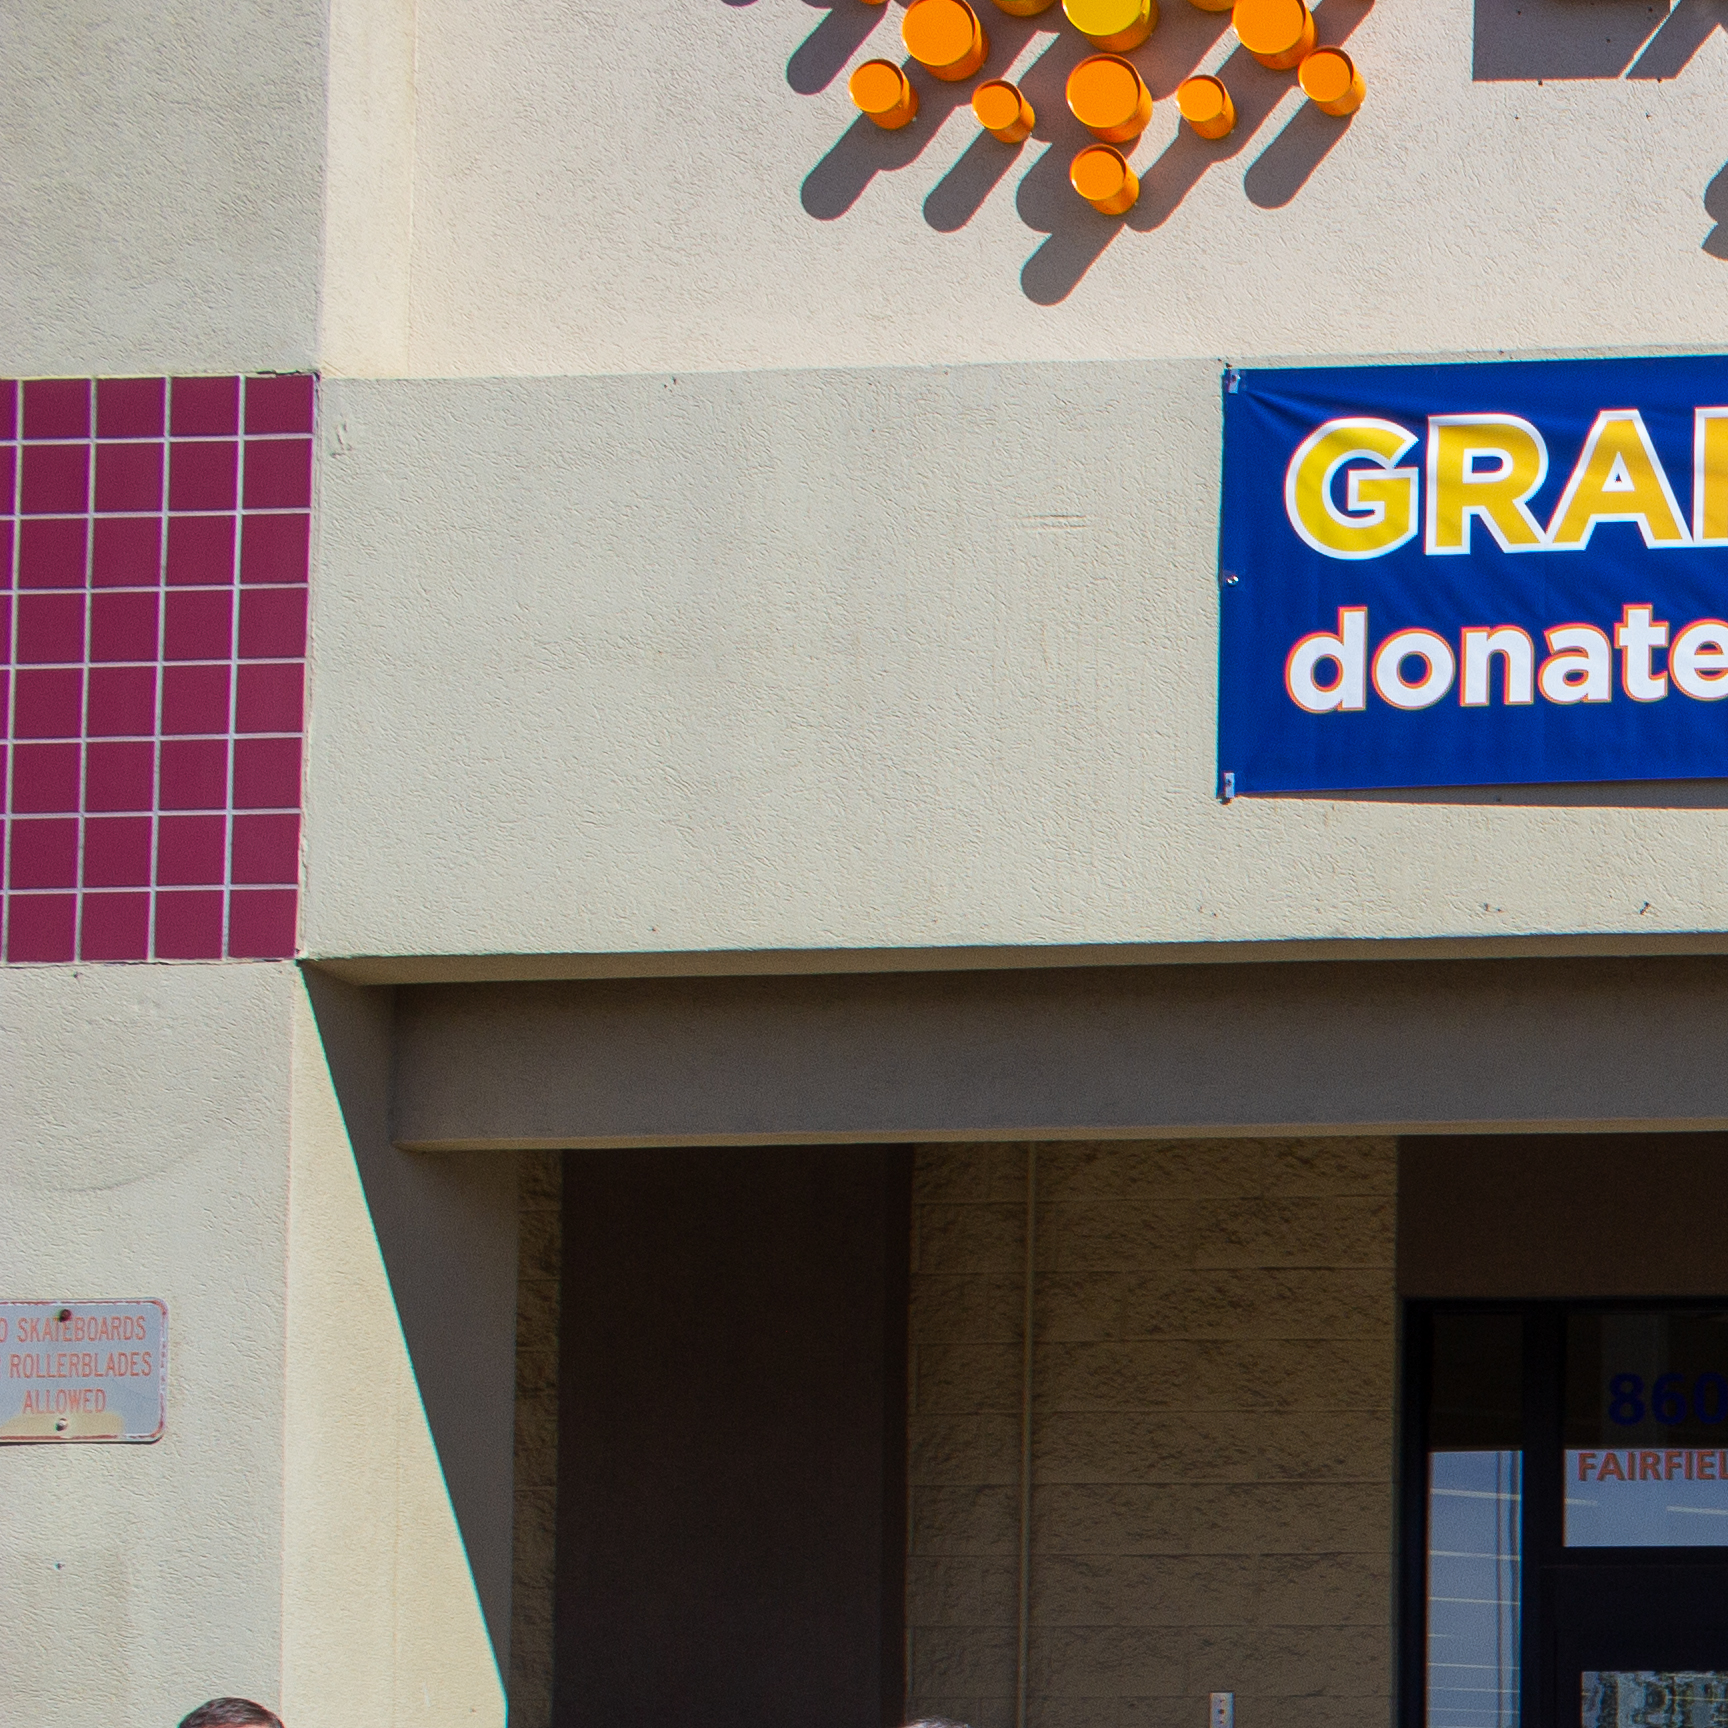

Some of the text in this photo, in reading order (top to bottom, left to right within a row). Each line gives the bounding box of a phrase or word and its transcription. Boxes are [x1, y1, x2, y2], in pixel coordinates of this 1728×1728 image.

[17, 1315, 146, 1343] SKATEBOARDS
[9, 1351, 153, 1379] ROLLERBLADES
[22, 1388, 107, 1415] ALLOWED
